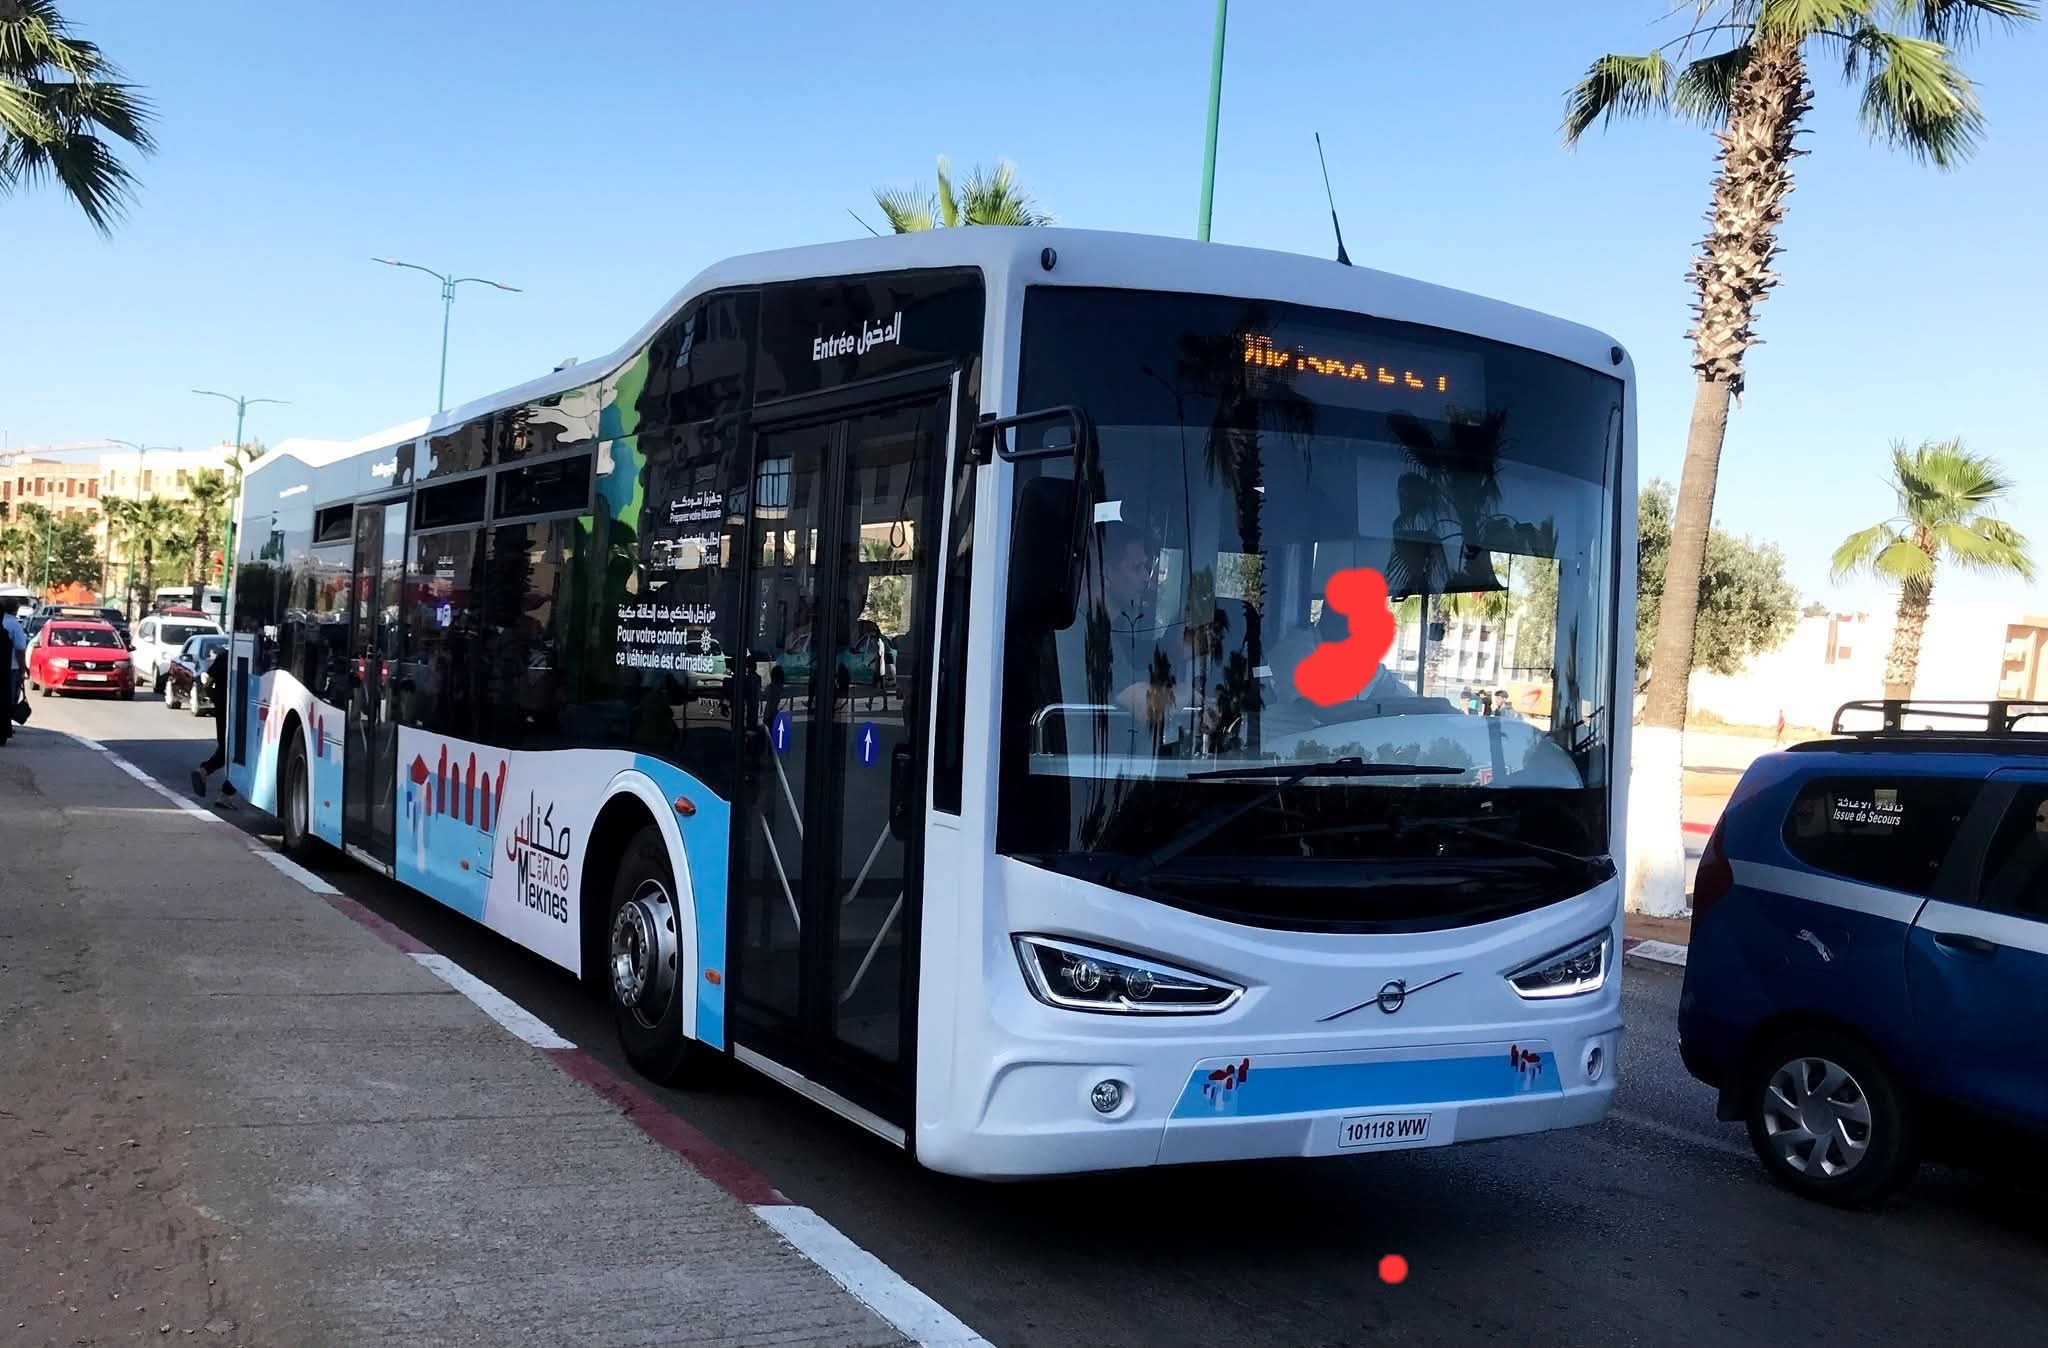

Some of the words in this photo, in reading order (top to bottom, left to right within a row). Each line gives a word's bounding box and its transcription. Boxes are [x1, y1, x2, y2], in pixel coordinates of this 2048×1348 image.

[813, 330, 854, 360] Entrée
[857, 311, 902, 355] الدخول
[618, 603, 636, 622] مكيفة
[617, 625, 636, 642] Pour
[637, 627, 656, 643] votre
[657, 627, 687, 645] confort
[616, 651, 625, 665] ce
[627, 648, 659, 668] véhicule
[660, 653, 673, 669] est
[675, 652, 713, 672] climatisé
[506, 789, 570, 862] مكناس
[1833, 808, 1854, 821] Issue
[1856, 811, 1866, 822] de
[1868, 811, 1901, 825] Secours
[517, 847, 567, 923] Meknes
[1347, 1121, 1394, 1140] 101118
[1398, 1118, 1427, 1136] WW
